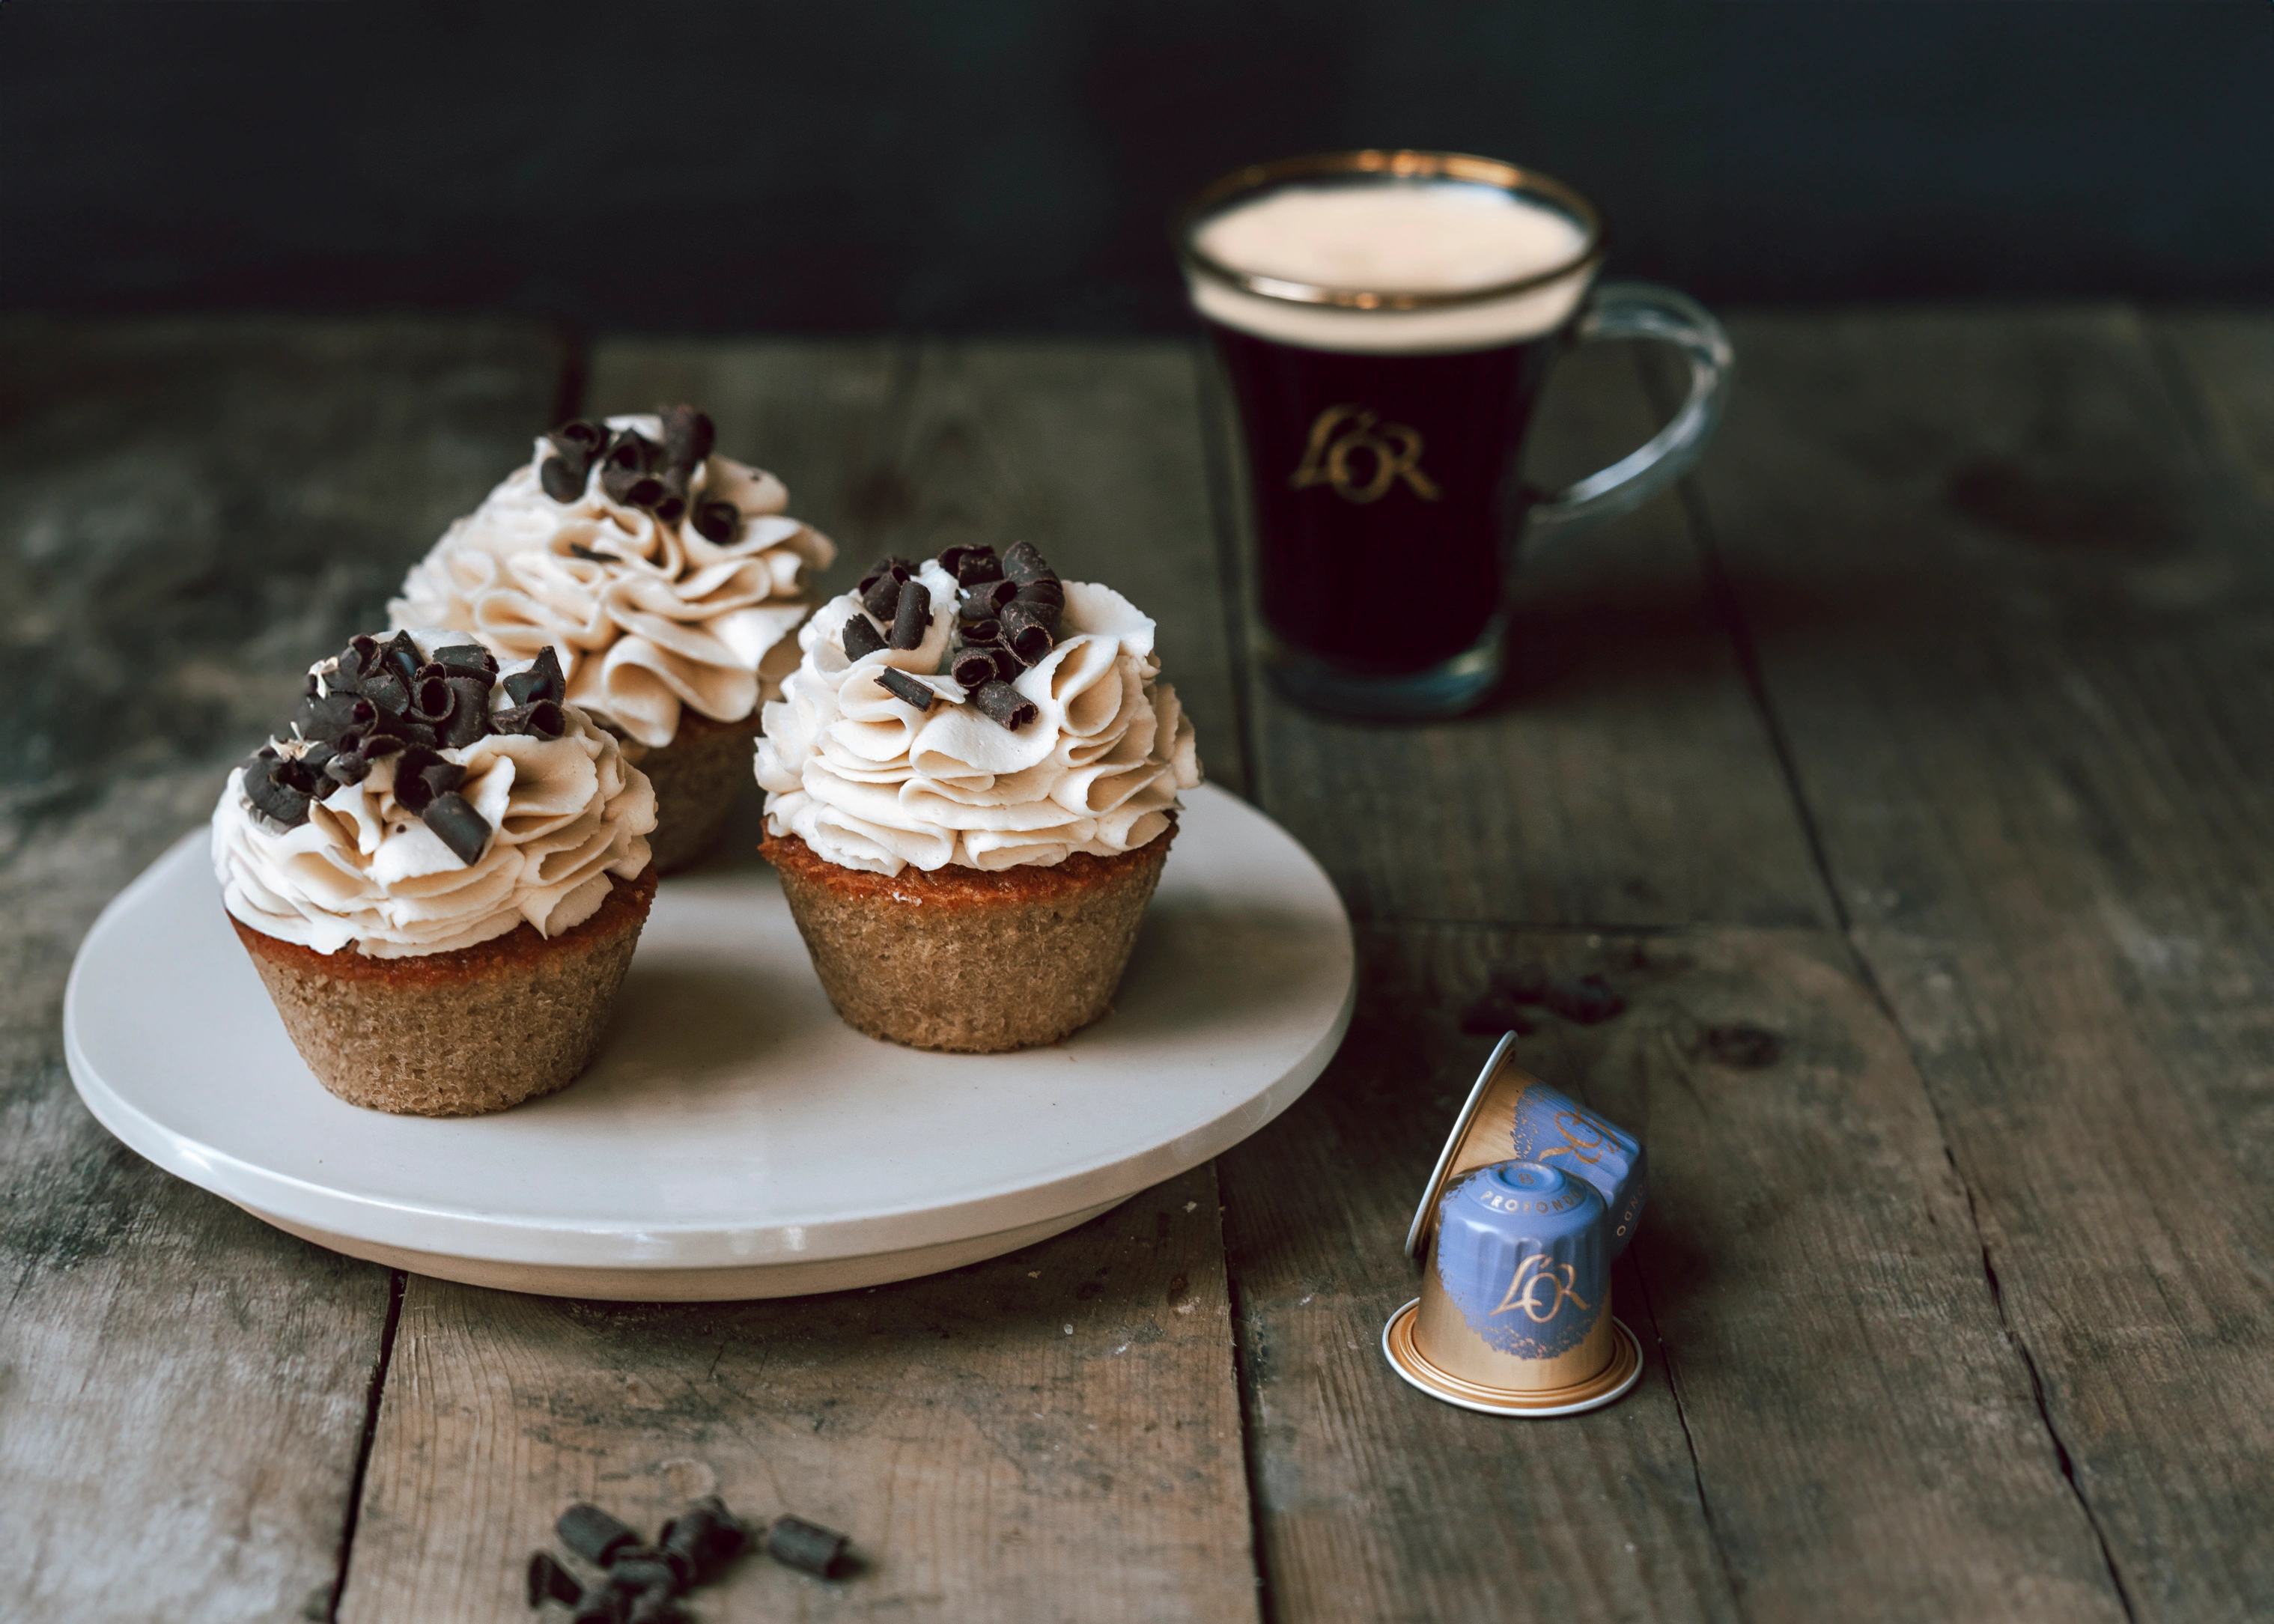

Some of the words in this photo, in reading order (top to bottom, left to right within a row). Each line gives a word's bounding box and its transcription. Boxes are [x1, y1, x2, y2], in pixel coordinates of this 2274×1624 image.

[1289, 404, 1443, 503] L'OR
[1480, 1187, 1582, 1214] PROFONDO
[1518, 1173, 1535, 1185] 8
[1490, 1253, 1590, 1323] L'OR
